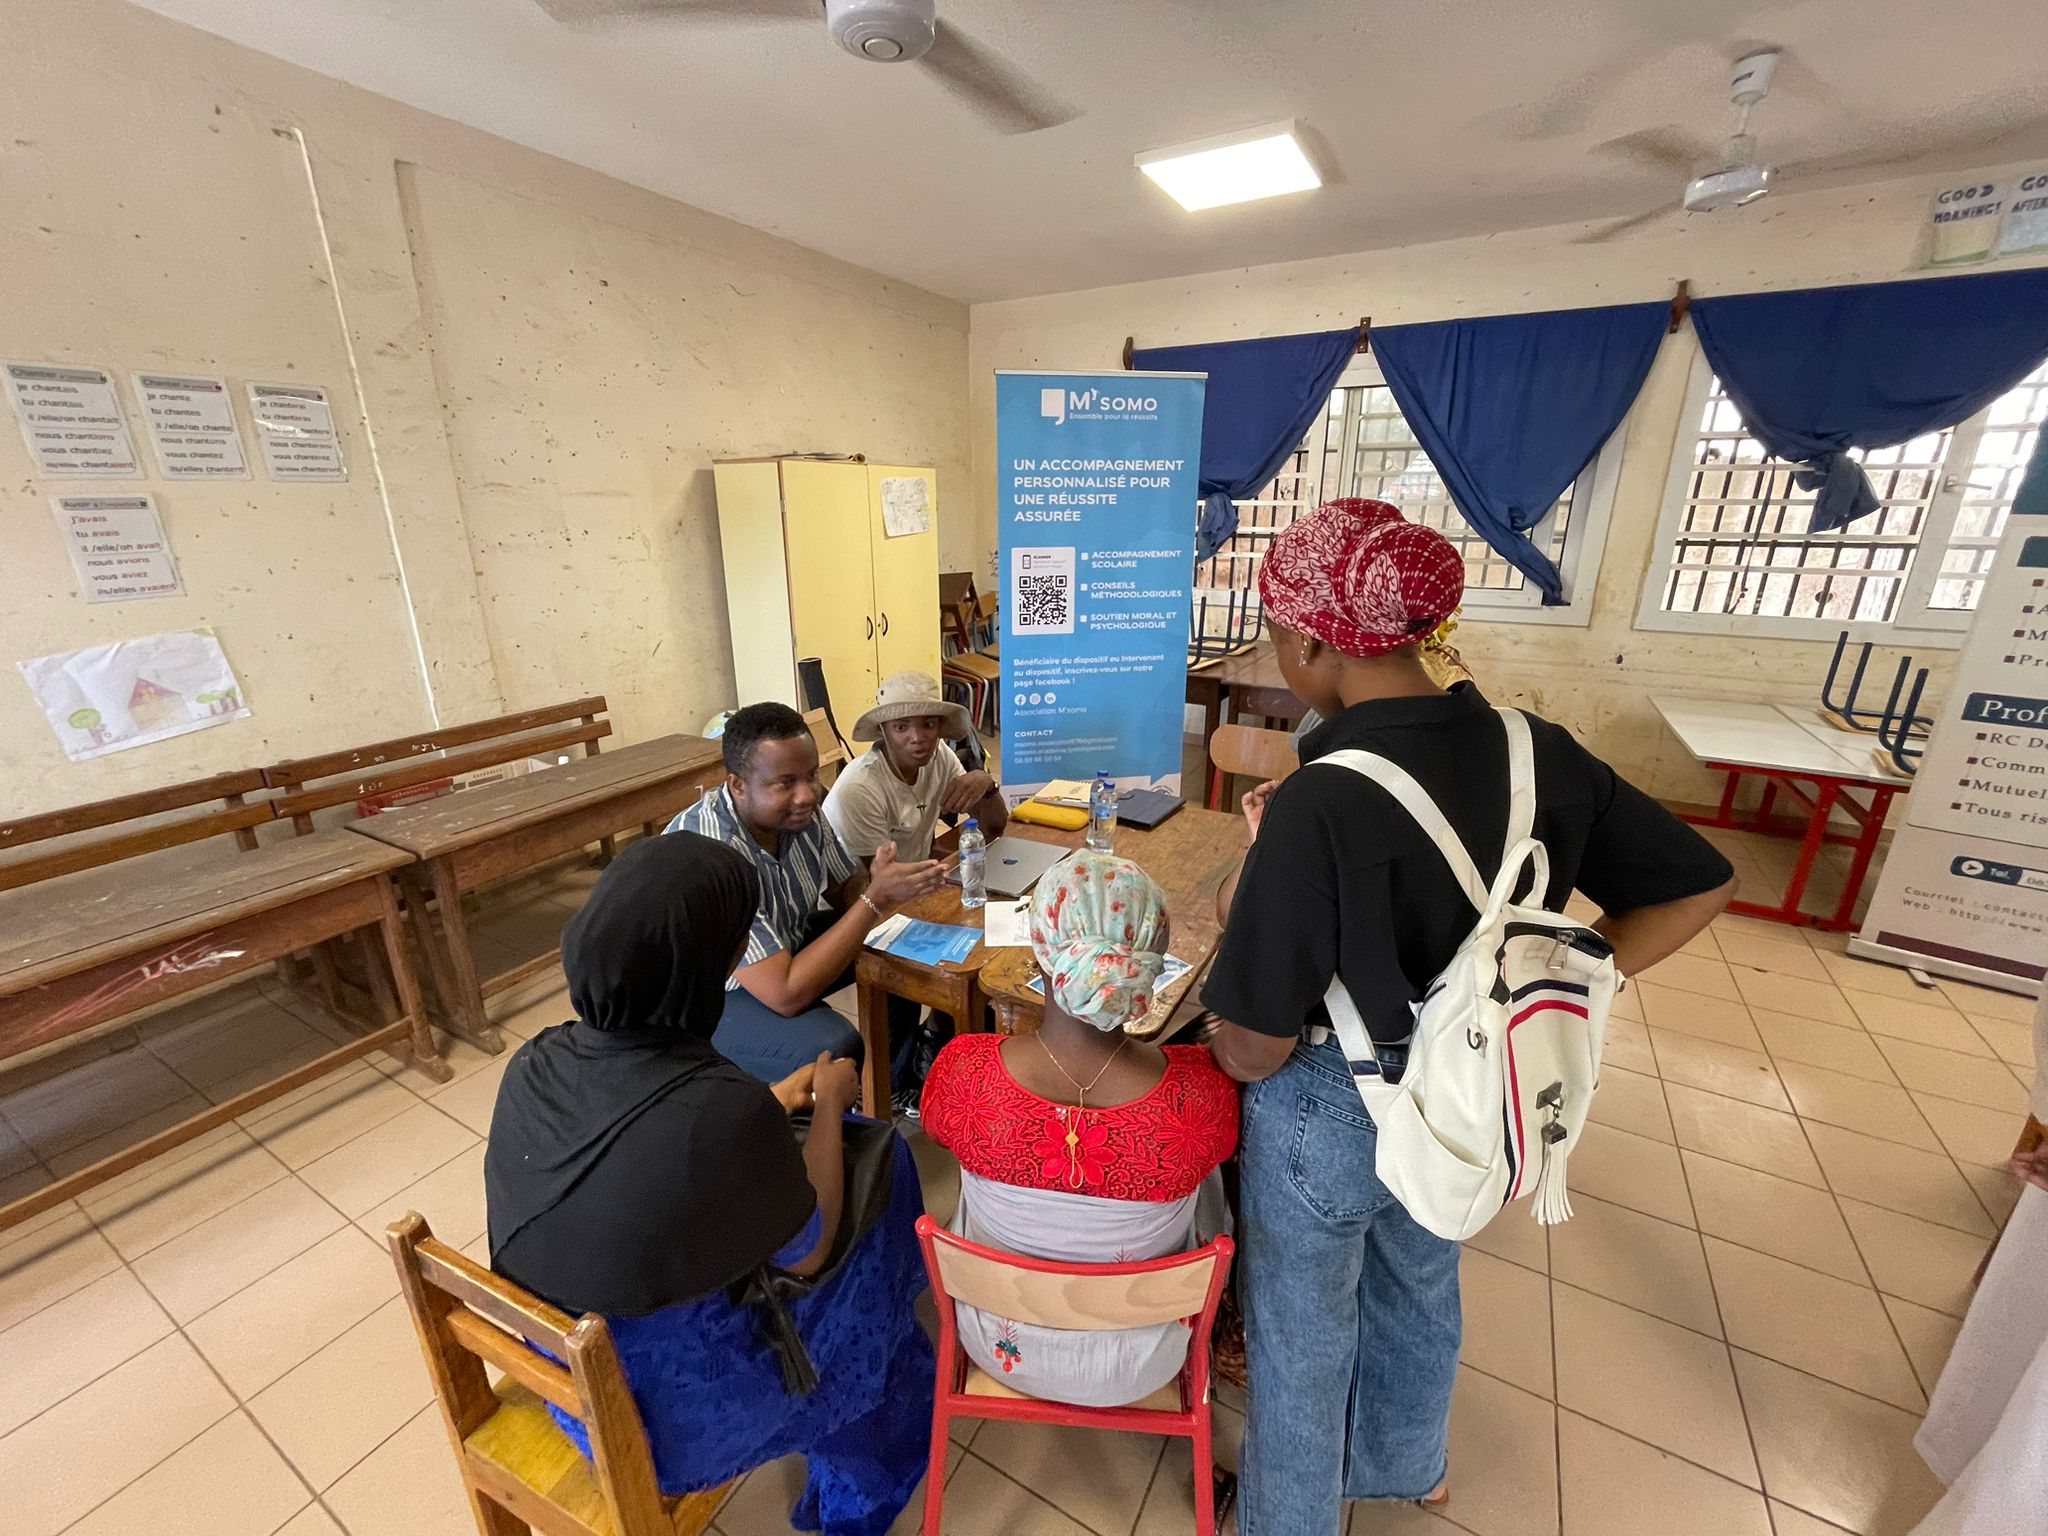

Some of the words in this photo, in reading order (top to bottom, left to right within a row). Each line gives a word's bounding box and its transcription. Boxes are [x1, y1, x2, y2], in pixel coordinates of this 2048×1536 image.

[1938, 184, 1994, 205] GOOD
[1013, 459, 1036, 471] UN
[1039, 459, 1185, 472] ACCOMPAGNEMENT
[1013, 475, 1127, 488] PERSONNALISÉ
[1130, 476, 1171, 488] POUR
[1013, 493, 1045, 505] UNE
[1048, 491, 1118, 506] RÉUSSITE
[1013, 508, 1082, 523] ASSURÉE
[1091, 549, 1183, 560] ACCOMPAGNEMENT
[87, 559, 115, 567] nous
[1091, 560, 1138, 569] SCOLAIRE
[92, 573, 119, 581] vous
[1090, 581, 1136, 590] CONSEILS
[1090, 589, 1183, 600] MÉTHODOLOGIQUES
[1090, 613, 1130, 622] SOUTIEN
[1131, 612, 1165, 621] MORAL
[1166, 611, 1178, 620] ET
[1090, 621, 1167, 631] PSYCHOLOGIQUE
[1013, 657, 1060, 667] Bénéficiaire
[1061, 657, 1072, 665] du
[1073, 655, 1109, 666] dispositif
[2018, 654, 2048, 667] Pr
[1064, 666, 1118, 675] inscrivez-vous
[1119, 665, 1132, 673] sur
[1133, 664, 1154, 672] notre
[1013, 680, 1034, 689] page
[1035, 678, 1071, 687] facebook
[1013, 707, 1057, 717] Association
[1014, 729, 1054, 738] CONTACT
[1989, 732, 2021, 746] RC
[1981, 756, 2046, 775] Comm
[1972, 779, 2048, 800] Mutuel
[1964, 801, 2012, 819] Tous
[1903, 898, 1931, 911] Web
